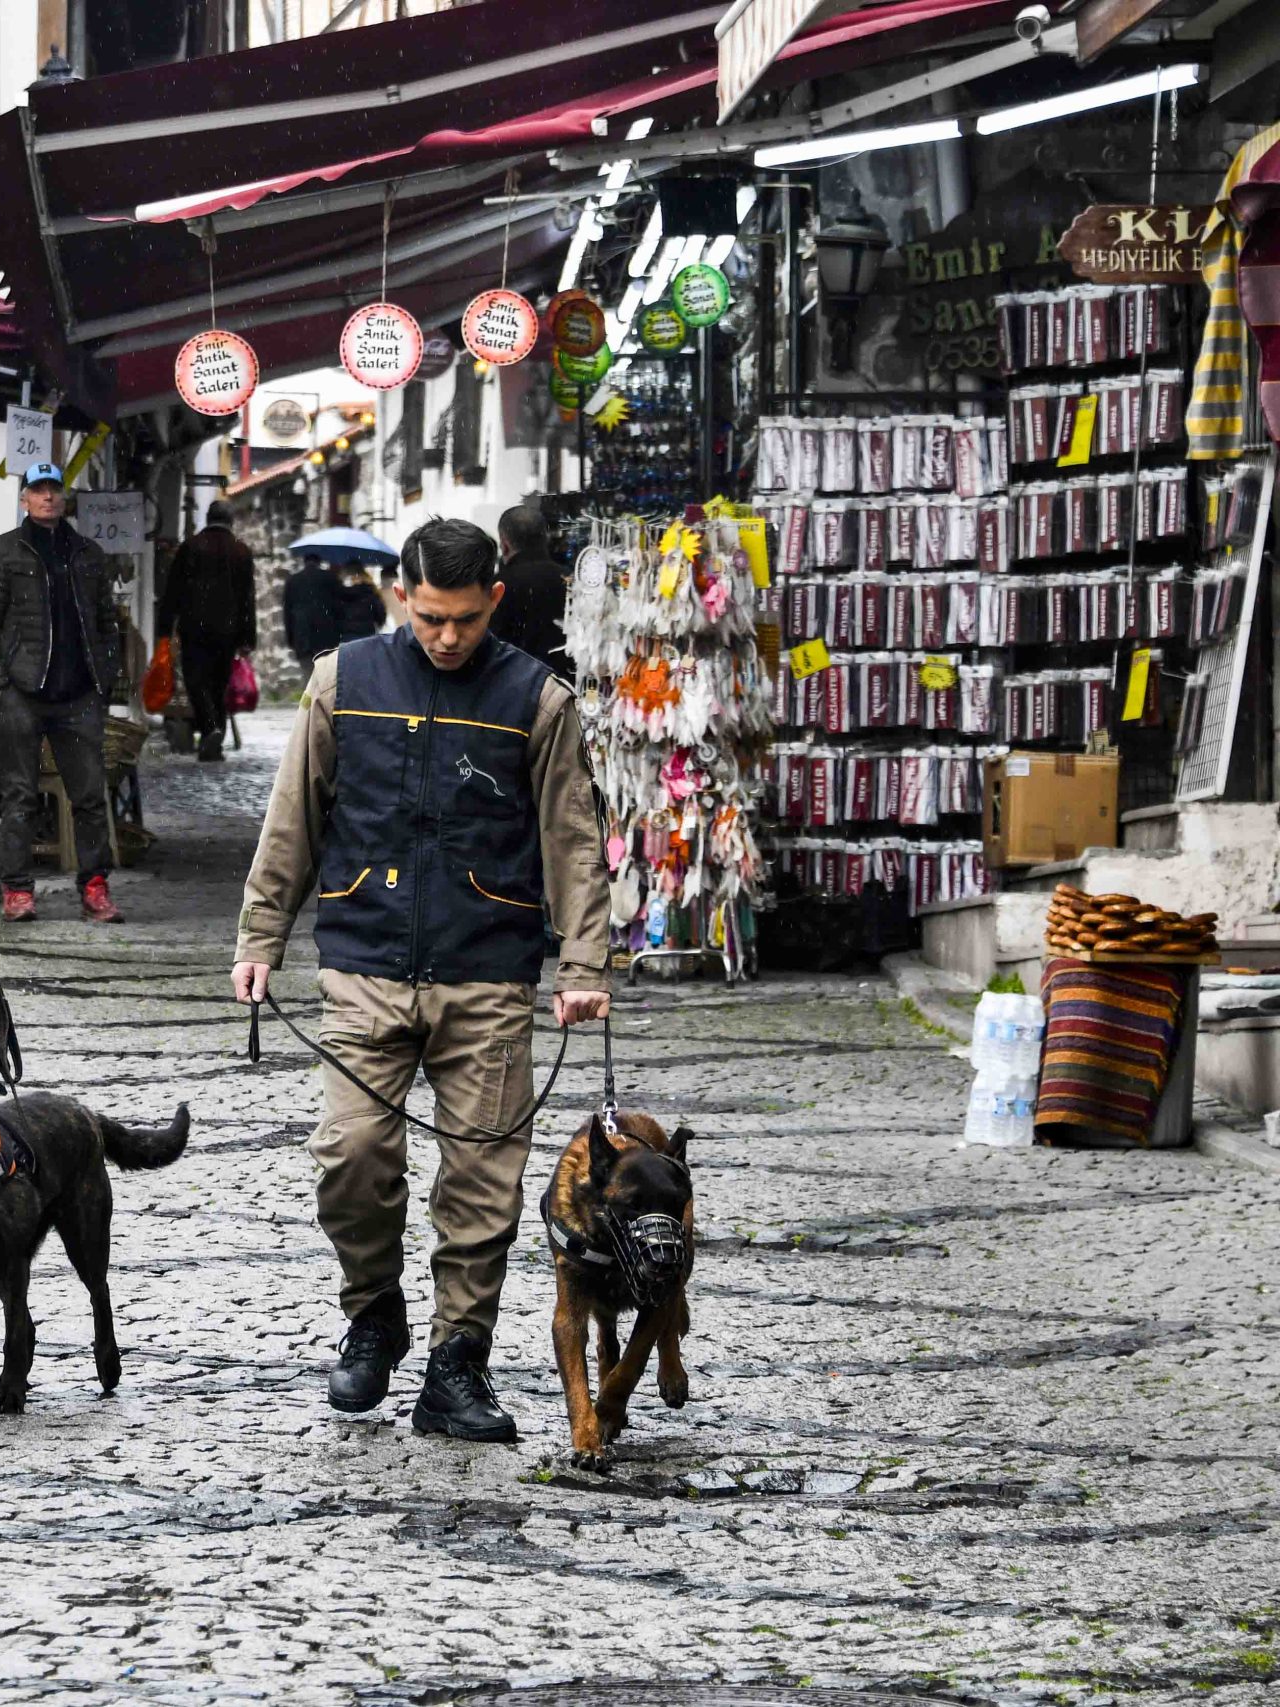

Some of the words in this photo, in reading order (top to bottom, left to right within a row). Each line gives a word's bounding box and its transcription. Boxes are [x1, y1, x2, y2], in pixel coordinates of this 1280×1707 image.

[905, 238, 1006, 283] Emir
[1082, 244, 1184, 272] HEDİYELİK
[488, 298, 520, 314] Emir
[366, 314, 399, 327] Emir
[477, 309, 519, 328] Antik
[357, 328, 404, 341] Antik
[478, 322, 517, 339] Sanat
[195, 338, 228, 352] Emir
[357, 343, 400, 356] Sanat
[475, 334, 515, 351] Galeri
[190, 351, 232, 366] Antik
[357, 358, 399, 370] Galeri
[193, 363, 238, 378] Sanat
[195, 377, 240, 395] Galeri
[985, 523, 994, 562] BURSA
[1160, 588, 1169, 631] YALOVA
[1091, 688, 1099, 732] İSTANBU
[459, 767, 472, 780] K9
[791, 769, 800, 802] KONYA
